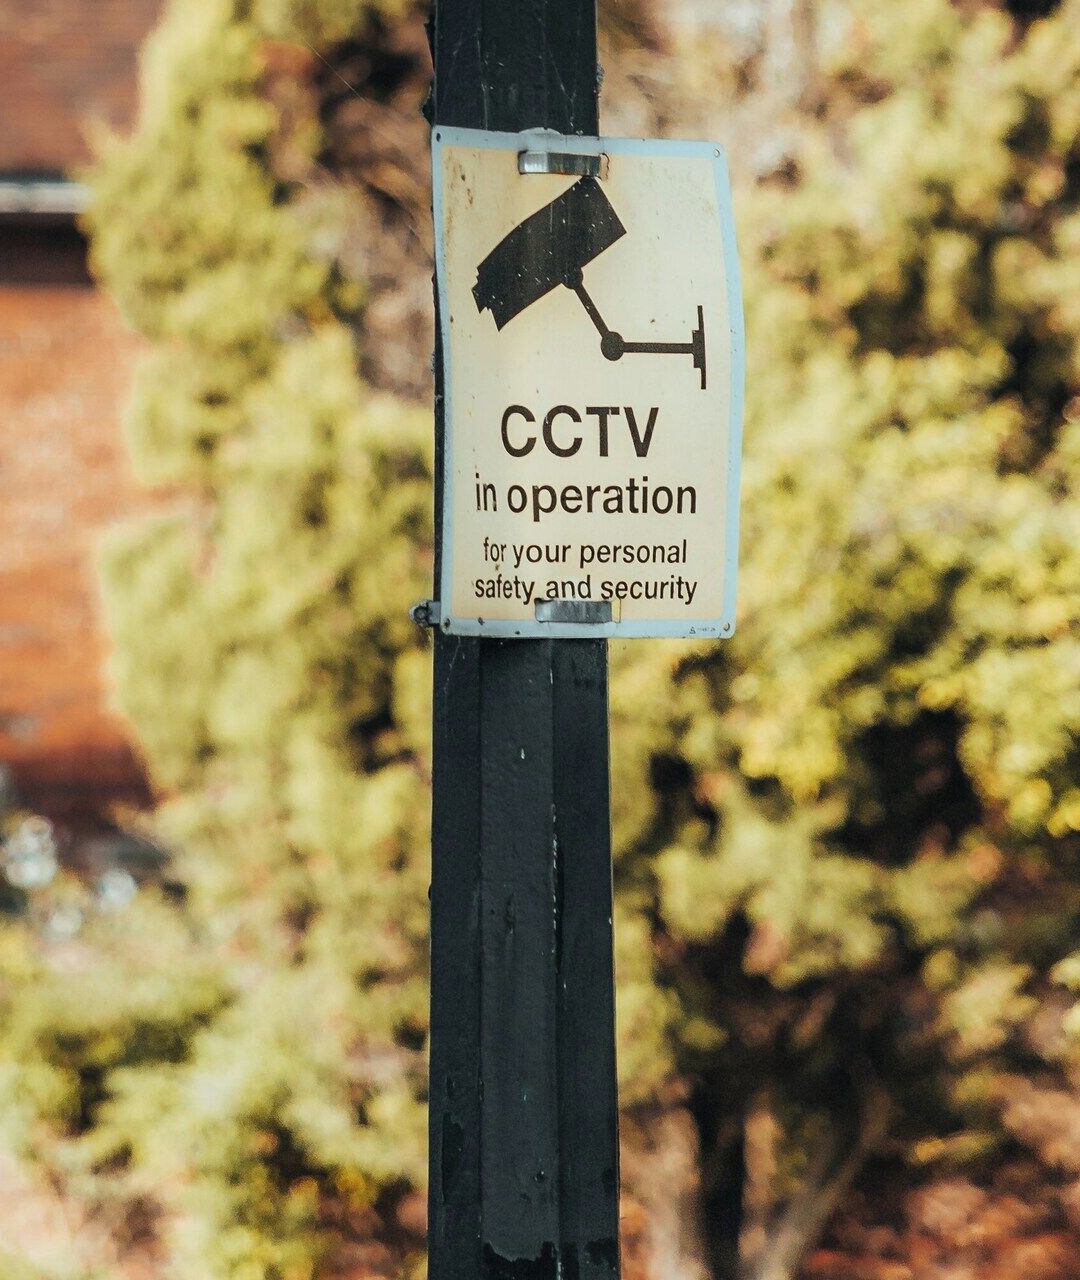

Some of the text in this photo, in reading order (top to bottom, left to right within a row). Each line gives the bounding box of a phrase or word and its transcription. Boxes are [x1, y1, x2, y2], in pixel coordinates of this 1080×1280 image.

[501, 405, 660, 458] CCTV
[475, 472, 697, 523] in operation
[483, 537, 687, 569] for your personal
[475, 573, 698, 606] safety and security
